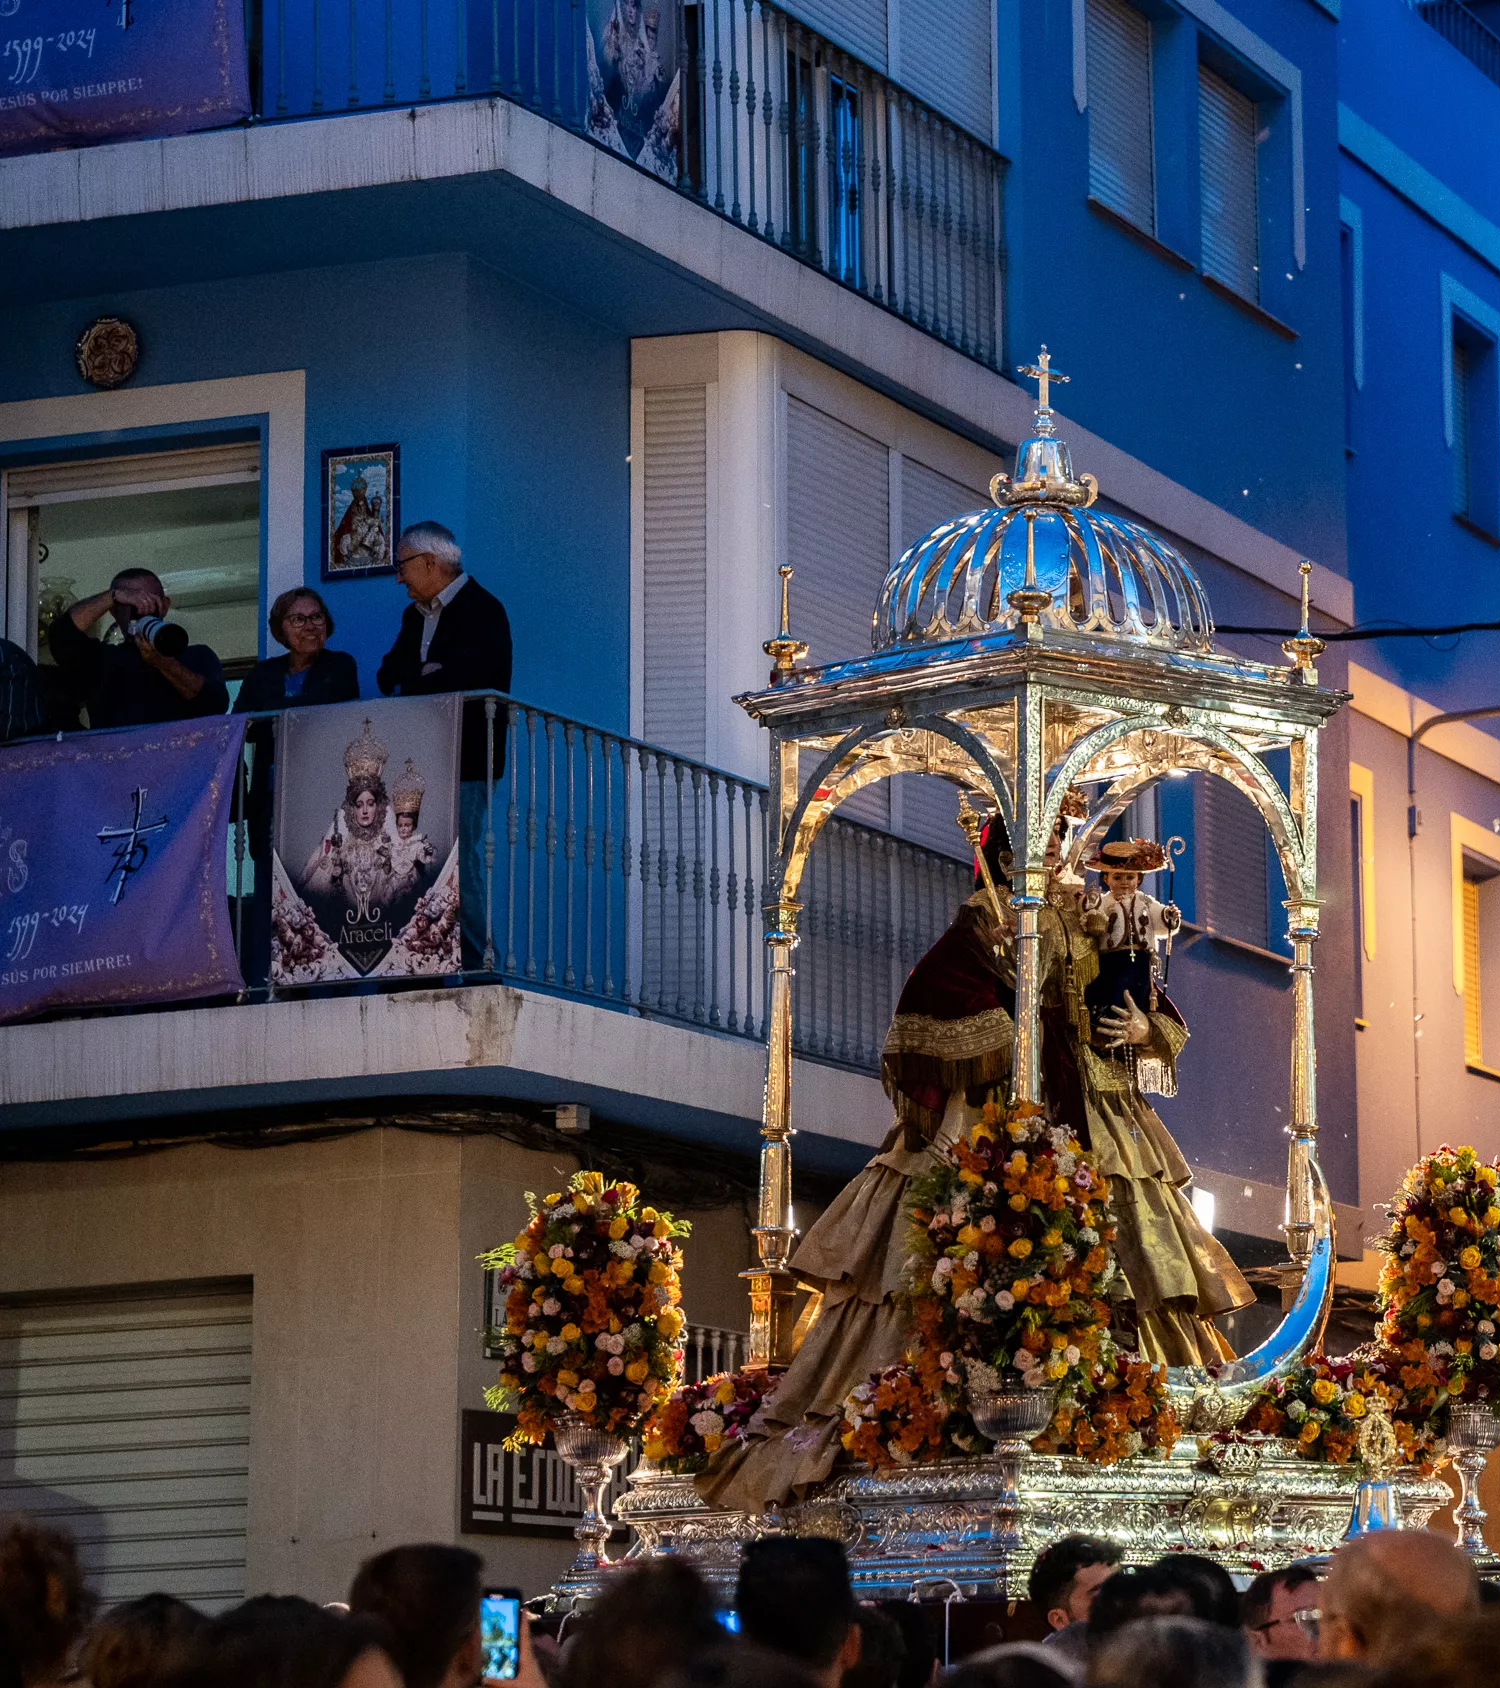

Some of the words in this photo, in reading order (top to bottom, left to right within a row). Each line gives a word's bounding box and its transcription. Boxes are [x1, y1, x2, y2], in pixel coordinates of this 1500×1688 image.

[3, 28, 96, 84] 1599-2024
[41, 88, 69, 104] POR
[73, 78, 143, 101] SIEMPRE!
[6, 904, 89, 961] 1599-2024
[339, 921, 392, 944] Araceli
[33, 964, 57, 981] POR
[61, 954, 132, 976] SIEMPRE!
[473, 1442, 505, 1507] LA
